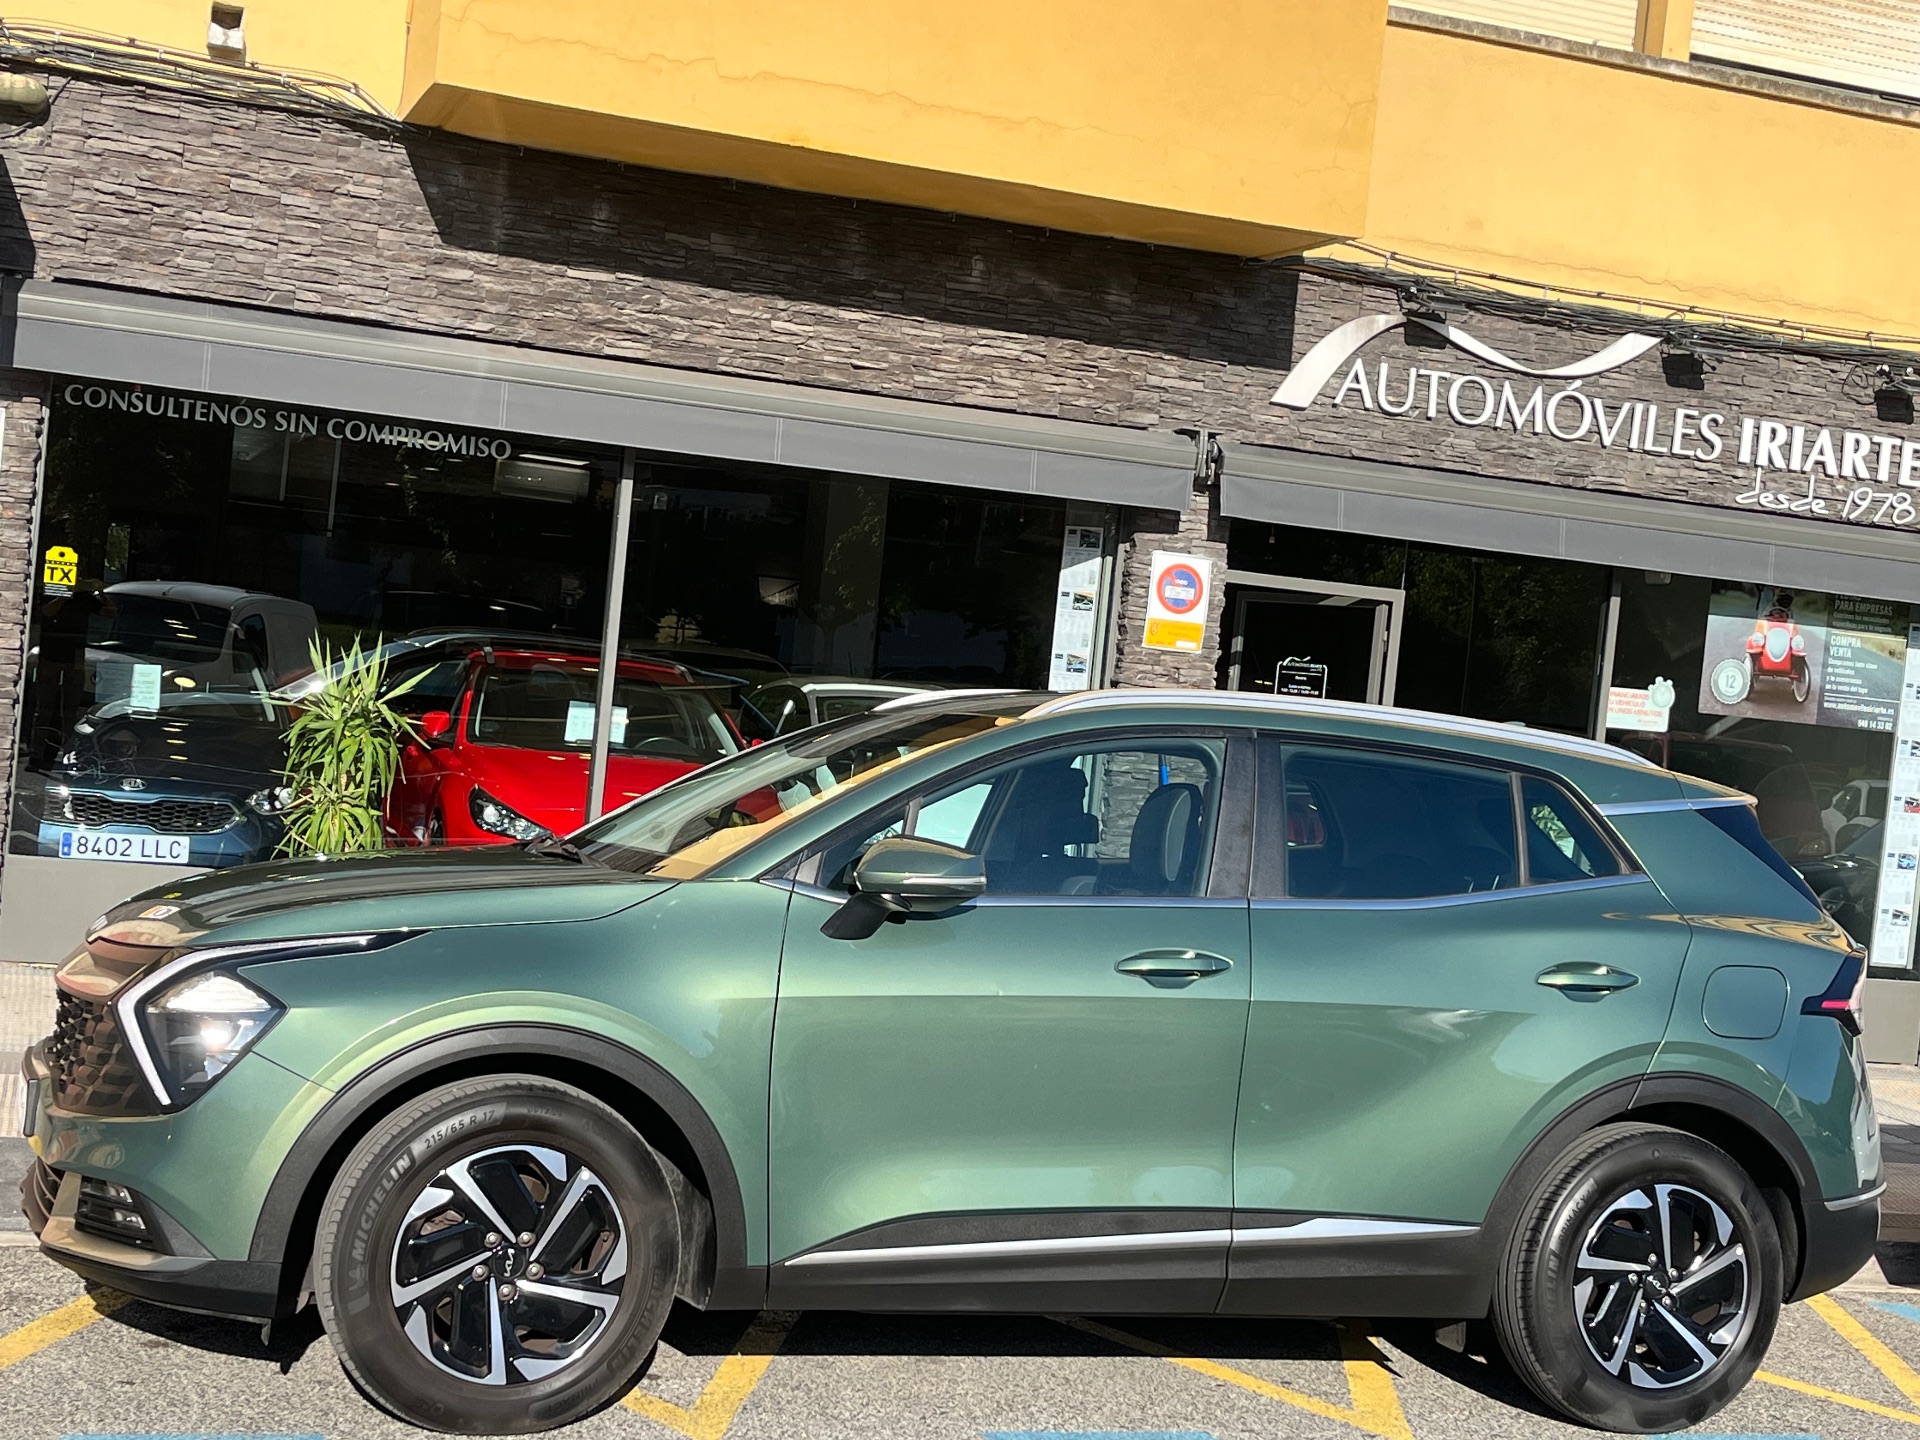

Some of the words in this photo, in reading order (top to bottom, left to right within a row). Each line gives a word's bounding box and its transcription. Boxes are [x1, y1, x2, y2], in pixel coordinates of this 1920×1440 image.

[63, 383, 267, 430] CONSULTENÓS
[273, 410, 319, 437] SIN
[326, 417, 512, 460] COMPROMISO
[1333, 356, 1725, 462] AUTOMÓVILES
[1737, 416, 1920, 488] IRIARTE
[1735, 466, 1830, 515] desde
[1841, 487, 1917, 525] 1978
[46, 565, 74, 584] TX
[1834, 600, 1854, 612] PARA
[1855, 602, 1893, 617] EMPRESAS
[1830, 635, 1862, 649] COMPRA
[1829, 646, 1852, 659] VENTA
[1724, 673, 1736, 690] 12
[1609, 690, 1650, 701] INANCIAMOS
[76, 835, 133, 857] 8402
[140, 838, 182, 860] LLC
[352, 1151, 414, 1262] MICHELIN
[423, 1118, 466, 1150] 215/65
[469, 1114, 479, 1127] R
[483, 1109, 496, 1123] 17
